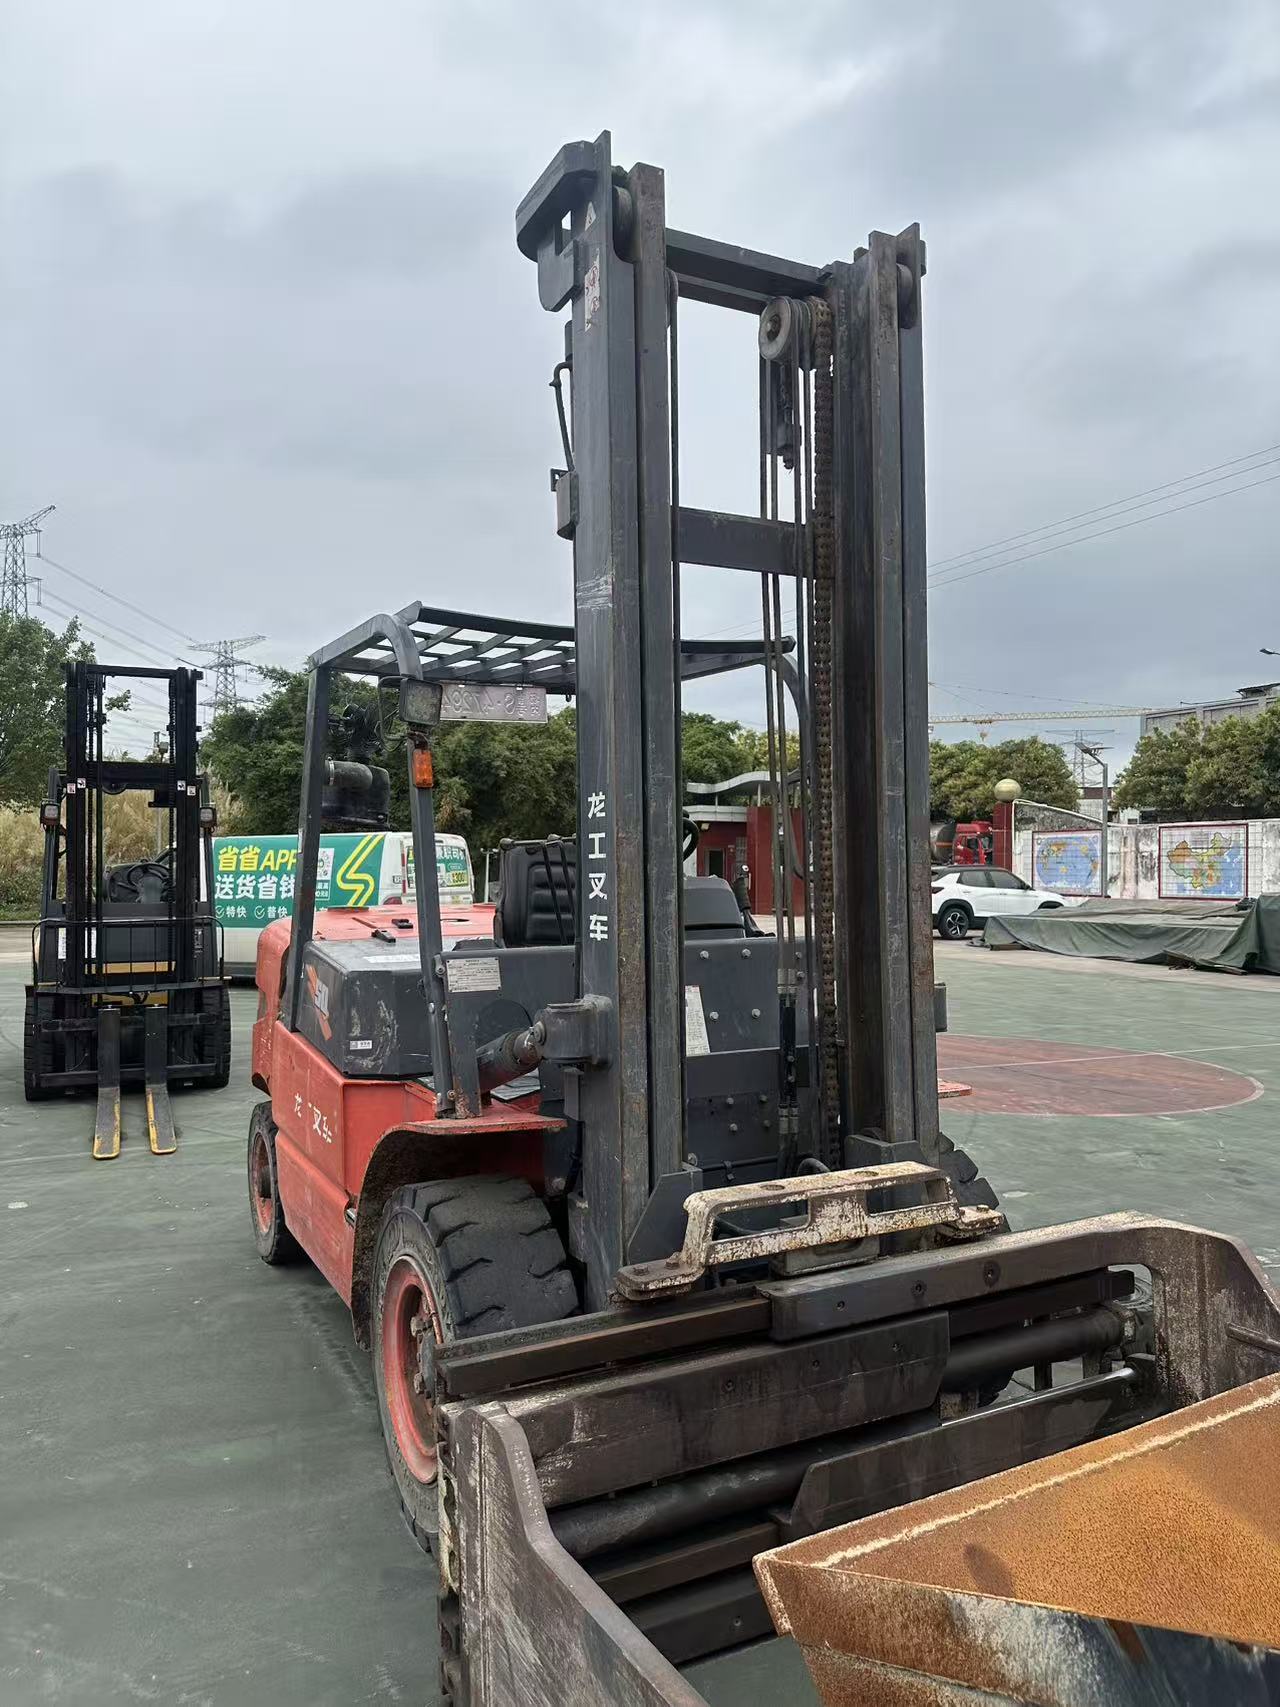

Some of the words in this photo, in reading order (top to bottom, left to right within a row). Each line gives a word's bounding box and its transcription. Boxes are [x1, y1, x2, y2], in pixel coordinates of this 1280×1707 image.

[587, 791, 608, 941] 龙工叉车
[214, 874, 296, 900] 送货省钱
[226, 905, 247, 918] 特快
[267, 905, 288, 918] 普快
